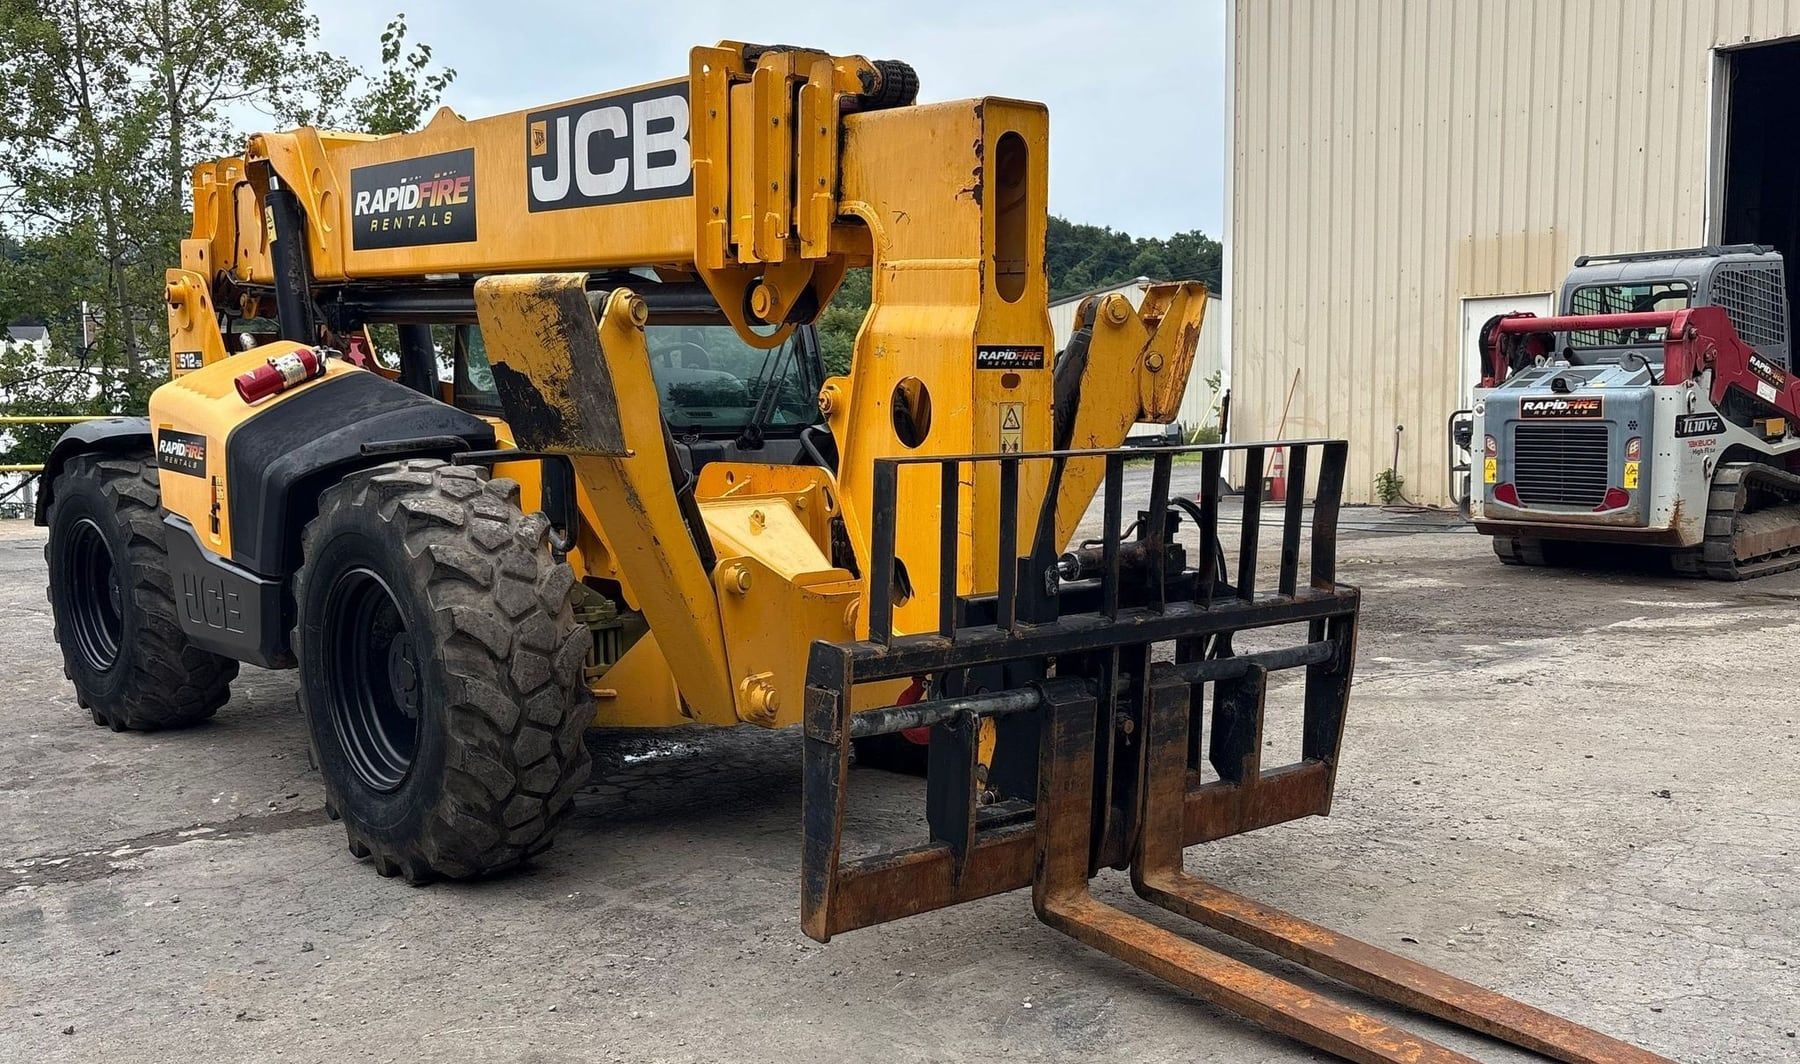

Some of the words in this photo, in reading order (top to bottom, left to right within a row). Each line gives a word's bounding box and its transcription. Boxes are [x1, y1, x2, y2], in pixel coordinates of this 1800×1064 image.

[531, 95, 691, 202] JCB
[355, 174, 470, 216] RAPIDFIRE
[370, 211, 453, 232] RENTALS
[978, 349, 1042, 360] RAPIDFIRE
[1523, 400, 1599, 410] RAPIDFIRE
[1684, 417, 1719, 433] TL10V2
[165, 456, 197, 468] RENTALS
